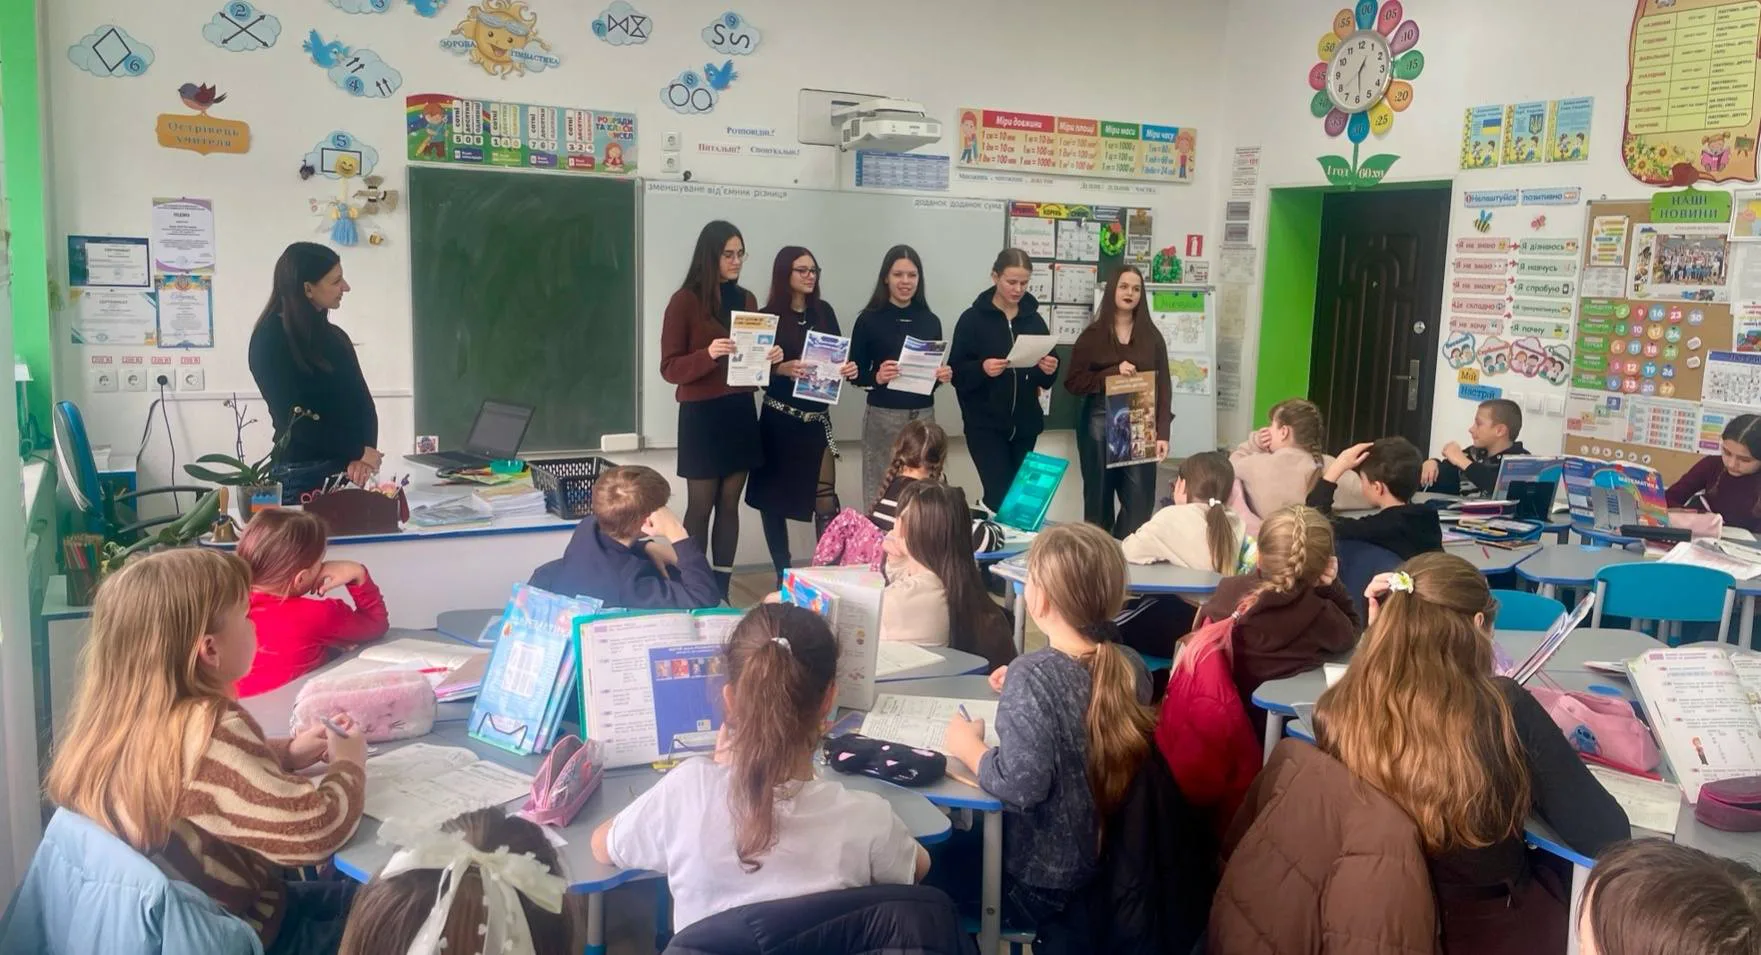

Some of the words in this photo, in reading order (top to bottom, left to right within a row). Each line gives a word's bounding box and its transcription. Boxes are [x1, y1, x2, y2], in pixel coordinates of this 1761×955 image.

[235, 4, 246, 17] 2
[728, 15, 735, 27] 9
[1338, 17, 1351, 28] :55
[1401, 29, 1413, 42] :10
[441, 39, 476, 49] ЗОРОВА
[1358, 41, 1366, 50] 12
[1371, 43, 1375, 51] 1
[1347, 47, 1353, 55] 11
[1378, 52, 1383, 61] 2
[129, 60, 140, 72] 6
[1339, 58, 1347, 66] 10
[1407, 59, 1418, 71] :15
[1380, 65, 1385, 73] 3
[1335, 72, 1341, 80] 9
[350, 79, 360, 92] 4
[1375, 79, 1380, 87] 4
[1338, 84, 1343, 93] 8
[1344, 93, 1349, 101] 7
[1366, 90, 1372, 99] 5
[1394, 91, 1408, 102] :20
[1355, 96, 1360, 104] 6
[996, 115, 1012, 128] Міри
[1375, 115, 1388, 126] :25
[1105, 125, 1120, 136] Міри
[337, 134, 347, 148] 5
[1359, 168, 1372, 179] 60
[647, 183, 705, 194] зменшуване
[1523, 193, 1562, 201] позитивно
[984, 203, 1002, 212] сума
[1660, 208, 1718, 218] НОВИНИ
[1526, 285, 1560, 294] спробую
[1638, 308, 1644, 316] 9
[1652, 309, 1663, 317] 16
[1670, 311, 1682, 320] 23
[1522, 325, 1545, 335] почну
[1646, 366, 1656, 374] 19
[1626, 380, 1636, 389] 13
[1619, 475, 1659, 489] МАТЕМАТИКА
